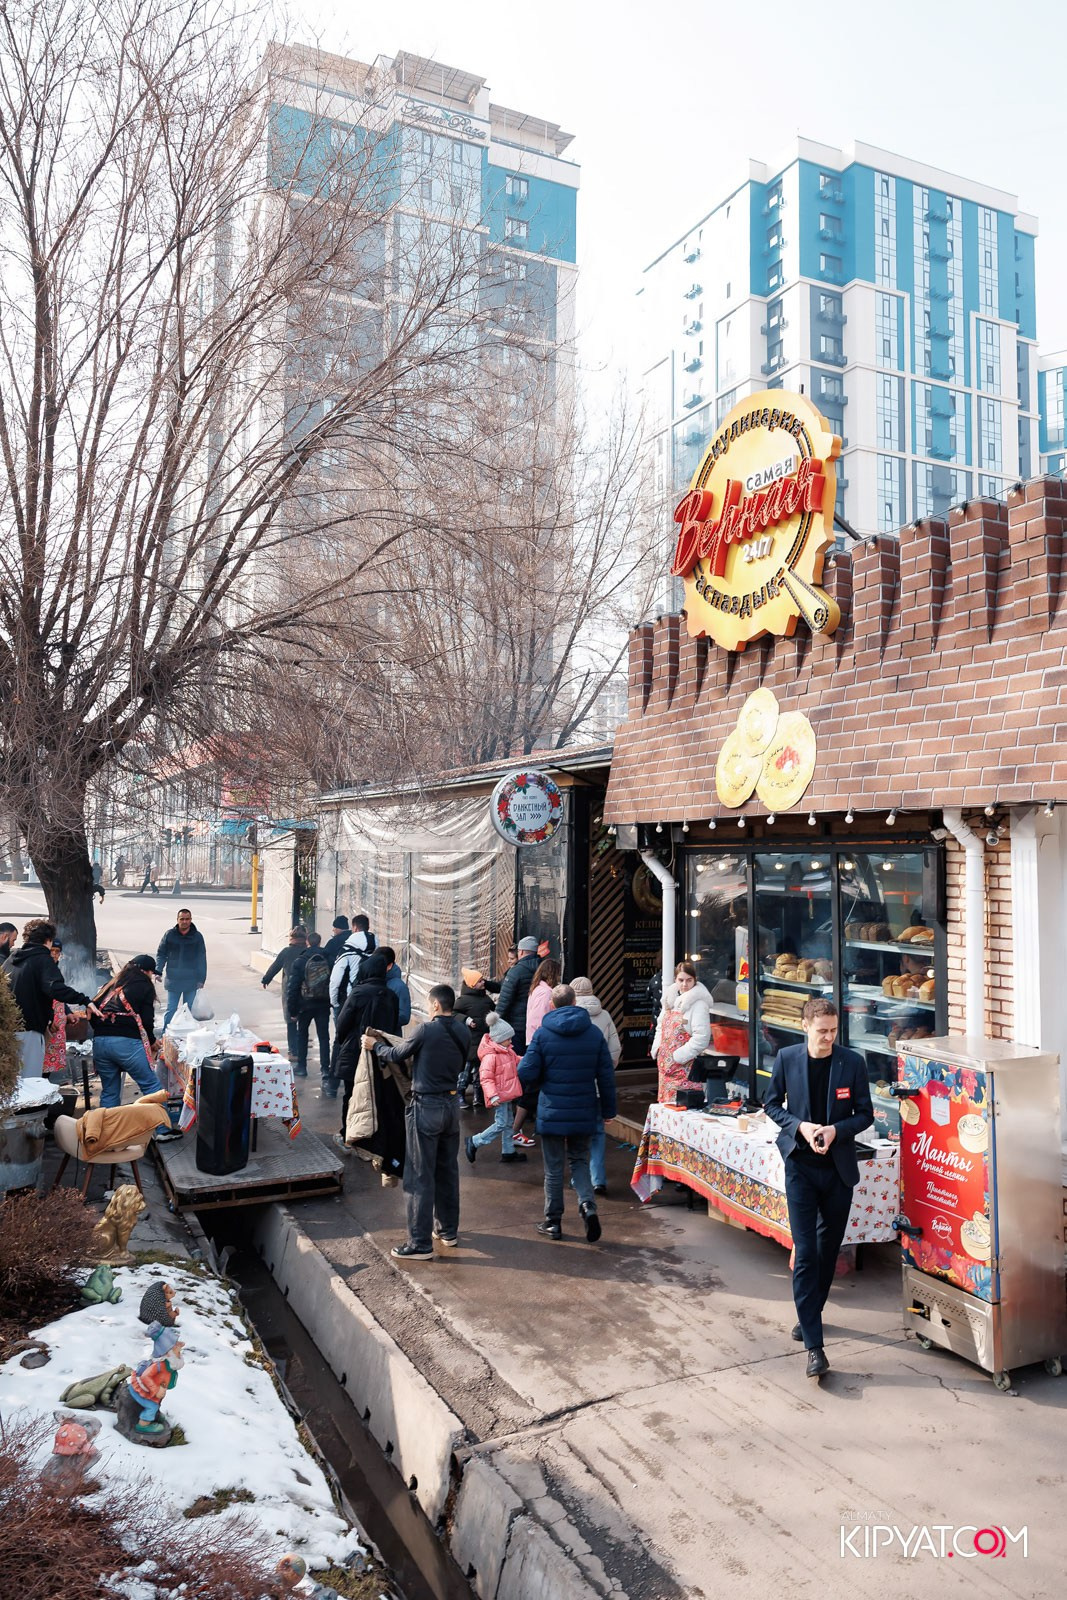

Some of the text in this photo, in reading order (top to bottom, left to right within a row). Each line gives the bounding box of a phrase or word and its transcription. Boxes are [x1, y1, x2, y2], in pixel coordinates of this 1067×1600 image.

[711, 407, 804, 460] кулинария
[746, 456, 795, 492] самая
[670, 456, 822, 577] Верная
[743, 536, 774, 563] 24/7
[516, 813, 527, 822] ЗАЛ
[911, 1131, 974, 1172] Манты
